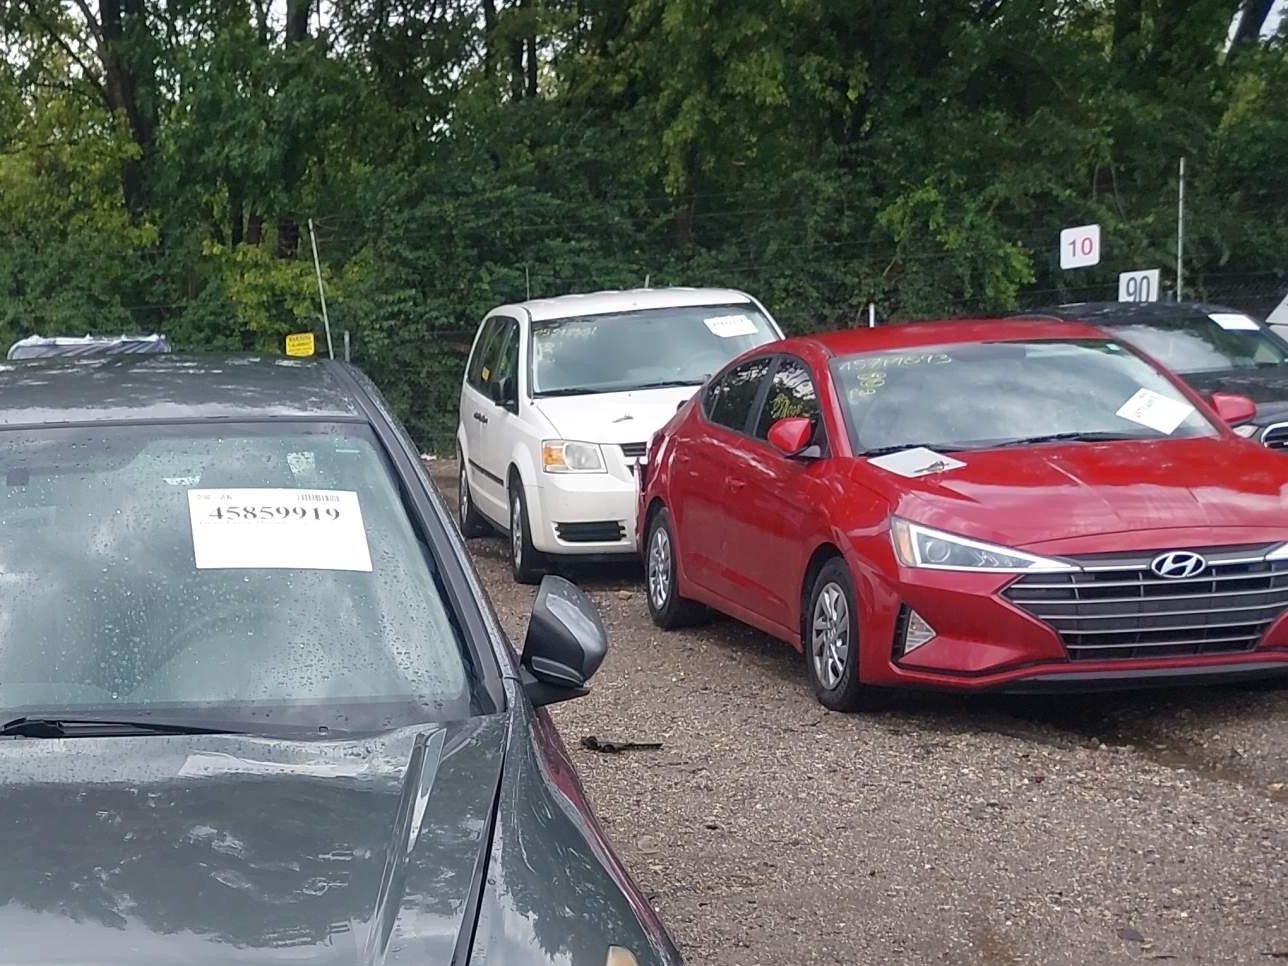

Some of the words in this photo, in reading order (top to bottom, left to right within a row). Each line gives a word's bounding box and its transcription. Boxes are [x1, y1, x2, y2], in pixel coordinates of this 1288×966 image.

[1067, 236, 1094, 257] 10
[1126, 275, 1151, 302] 90
[208, 506, 341, 520] 45859919
